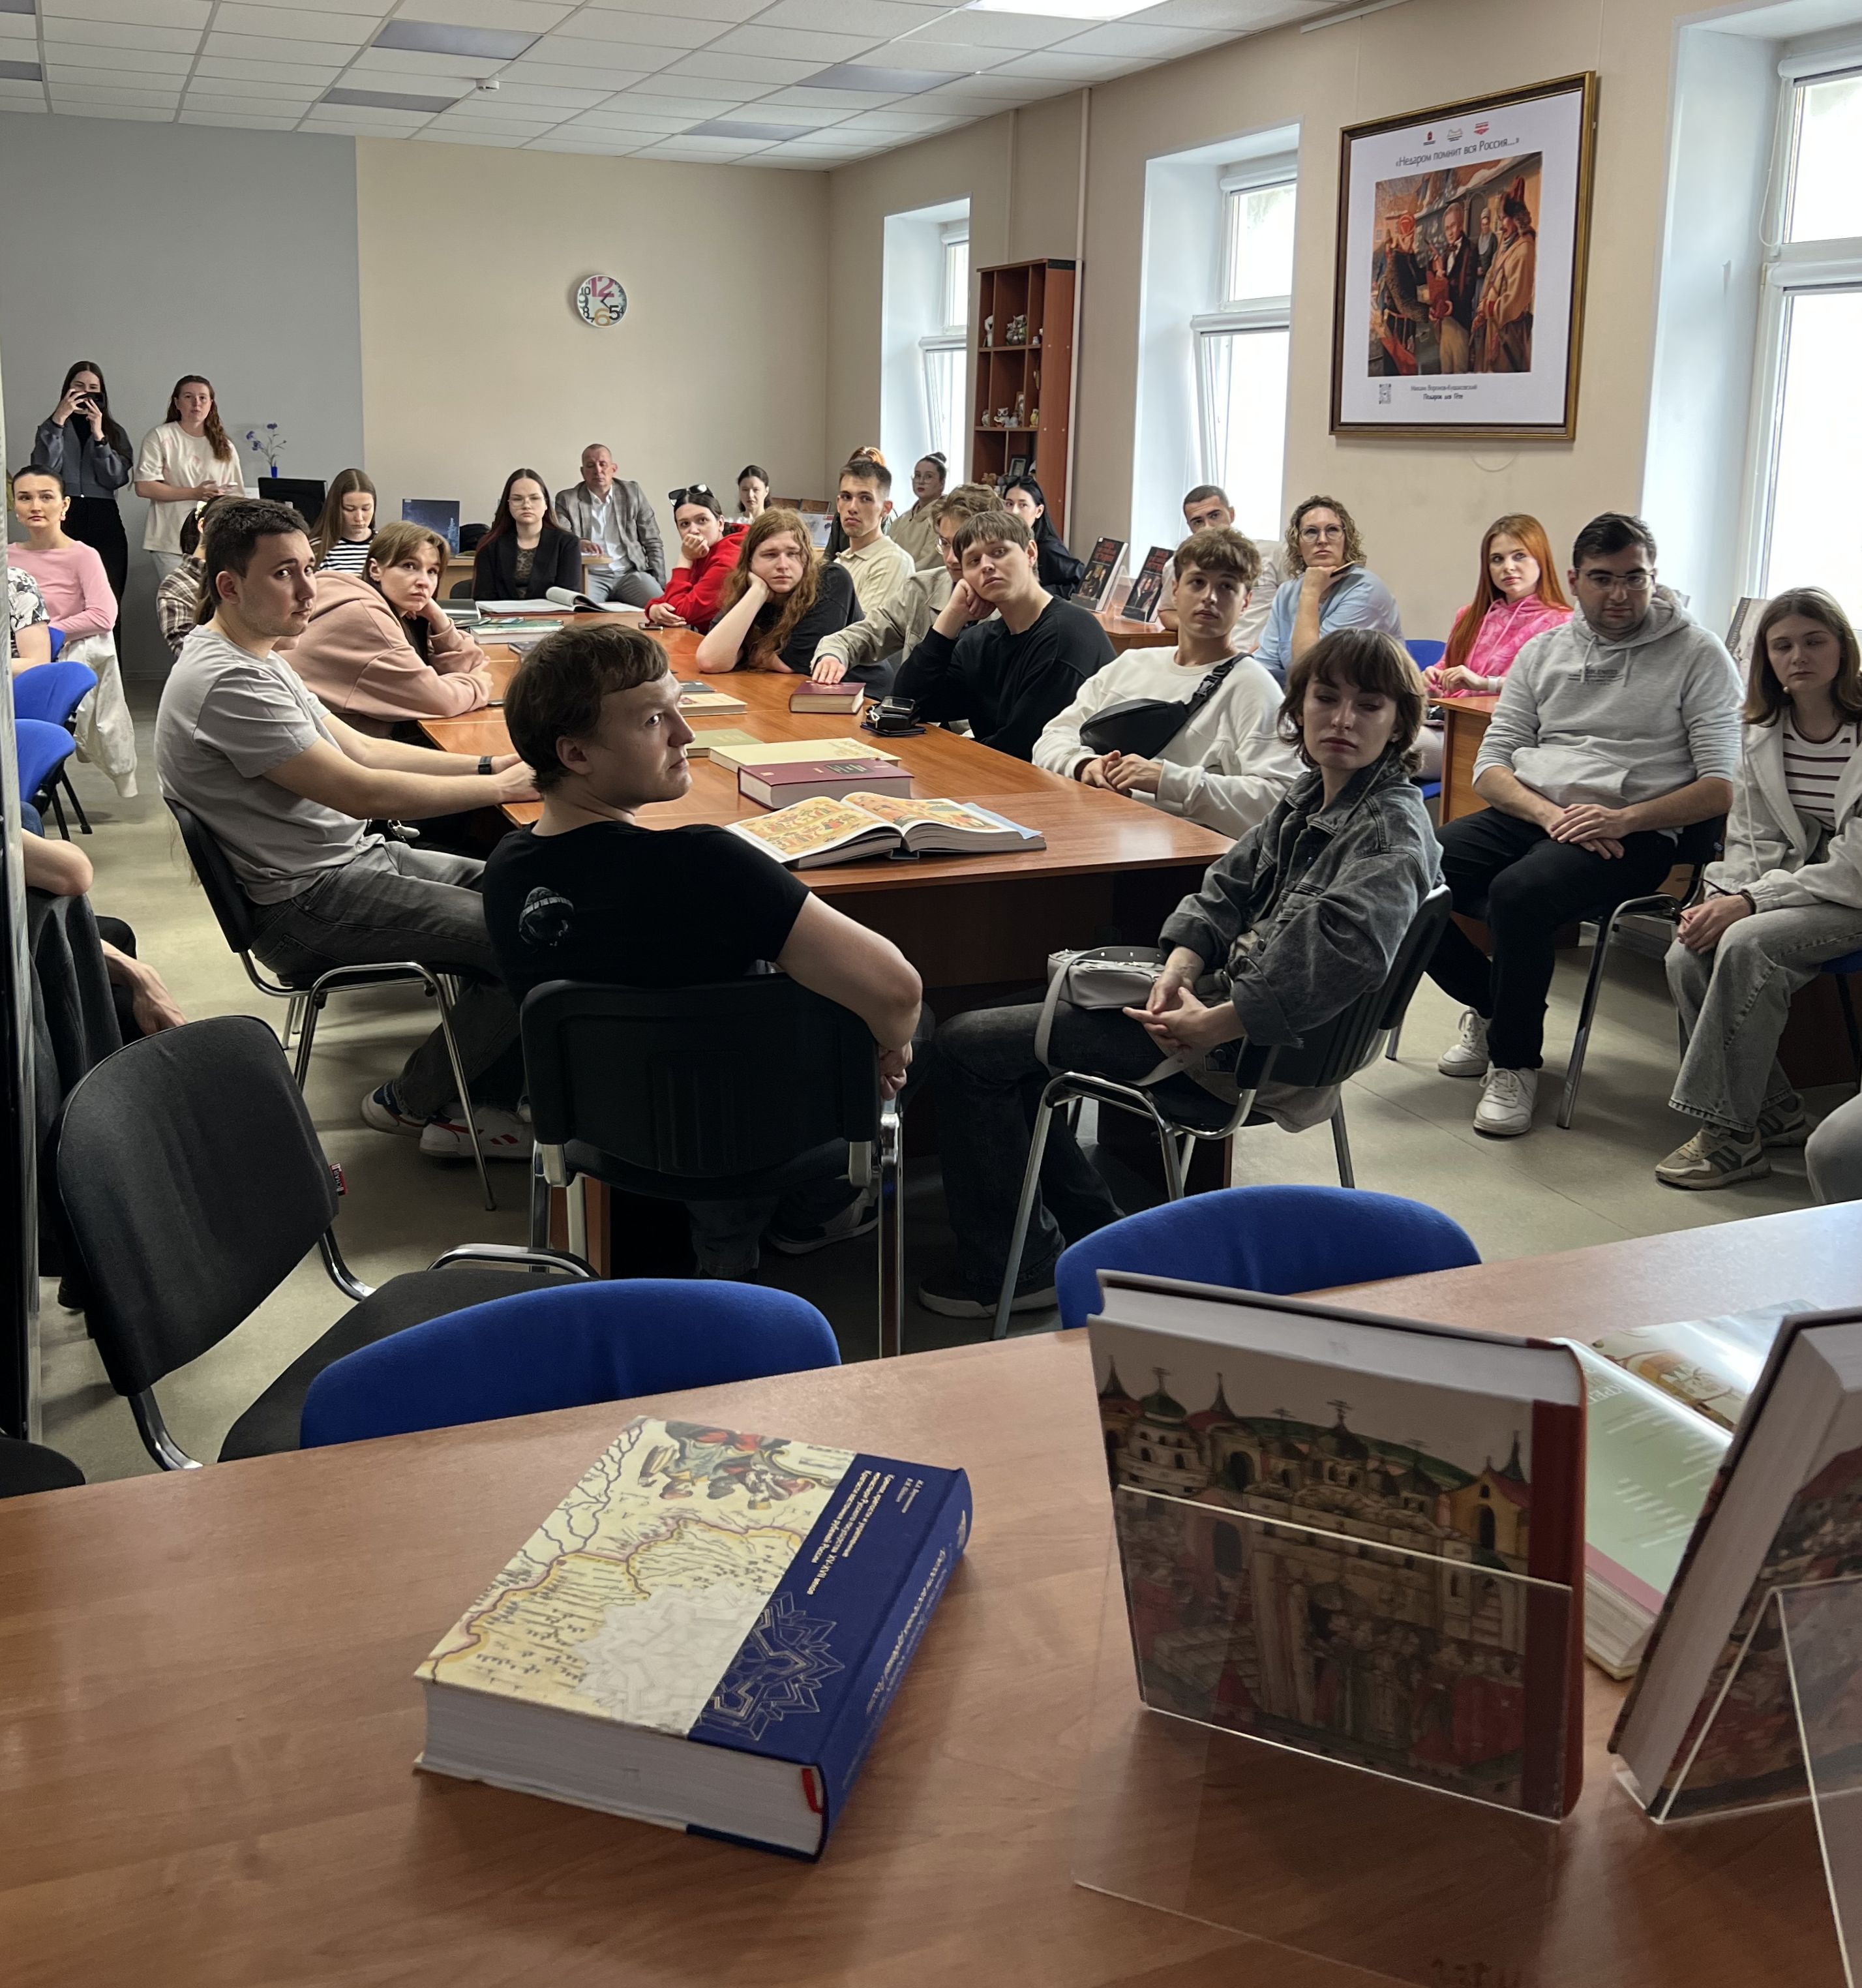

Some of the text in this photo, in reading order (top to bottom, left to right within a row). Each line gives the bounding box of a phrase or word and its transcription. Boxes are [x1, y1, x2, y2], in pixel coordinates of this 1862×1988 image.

[1433, 148, 1462, 160] помнит
[1464, 143, 1477, 154] вся
[591, 276, 614, 297] 12
[595, 308, 610, 326] 6
[609, 305, 620, 320] 5
